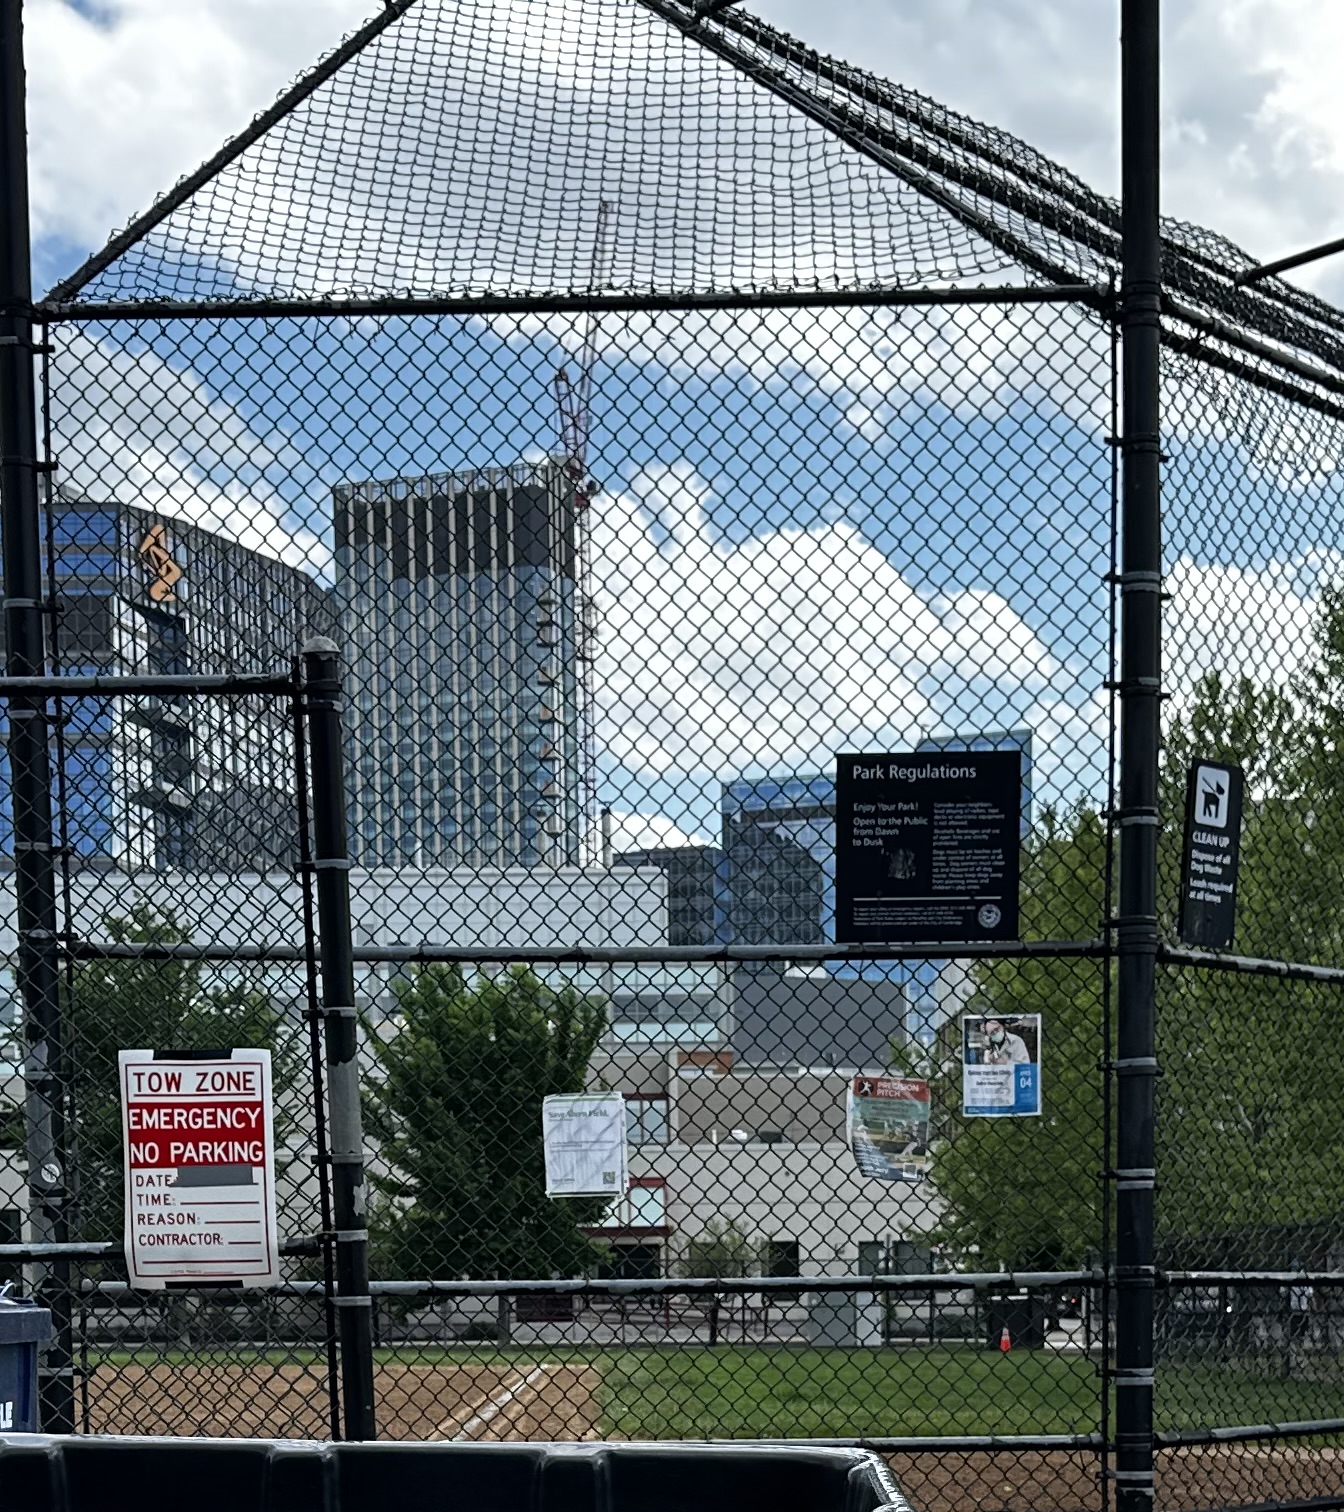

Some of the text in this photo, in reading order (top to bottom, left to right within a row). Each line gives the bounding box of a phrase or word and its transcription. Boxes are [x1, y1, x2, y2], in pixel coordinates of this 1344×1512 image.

[853, 764, 977, 782] Park Regulations
[1192, 831, 1230, 848] CLEAN UP
[133, 1071, 255, 1092] TOW ZONE
[1020, 1077, 1032, 1088] 04
[877, 1089, 901, 1097] PITCH
[129, 1108, 260, 1129] EMERGENCY
[131, 1141, 263, 1163] NO PARKING
